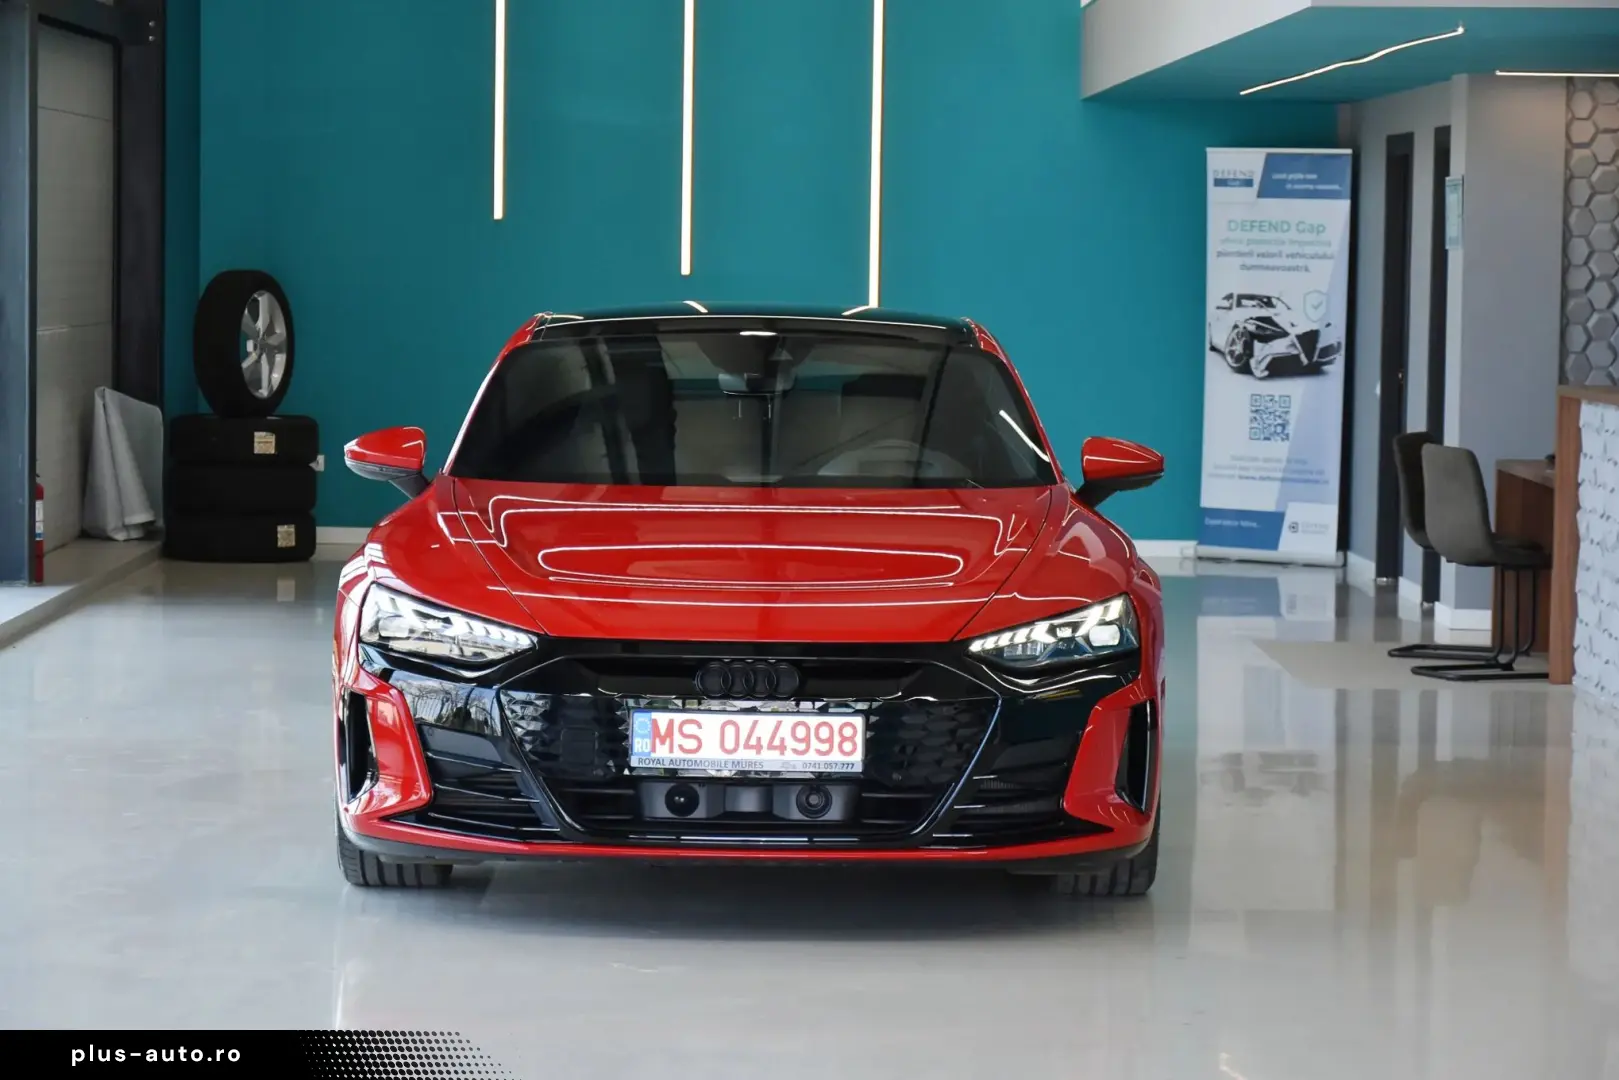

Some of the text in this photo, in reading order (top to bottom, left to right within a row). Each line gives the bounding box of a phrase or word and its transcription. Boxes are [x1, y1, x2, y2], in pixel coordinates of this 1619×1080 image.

[1228, 219, 1327, 236] DEFEND Gap
[635, 738, 651, 752] RO
[651, 718, 858, 757] MS 044998
[638, 757, 666, 767] ROYAL
[668, 758, 729, 769] AUTOMOBILE
